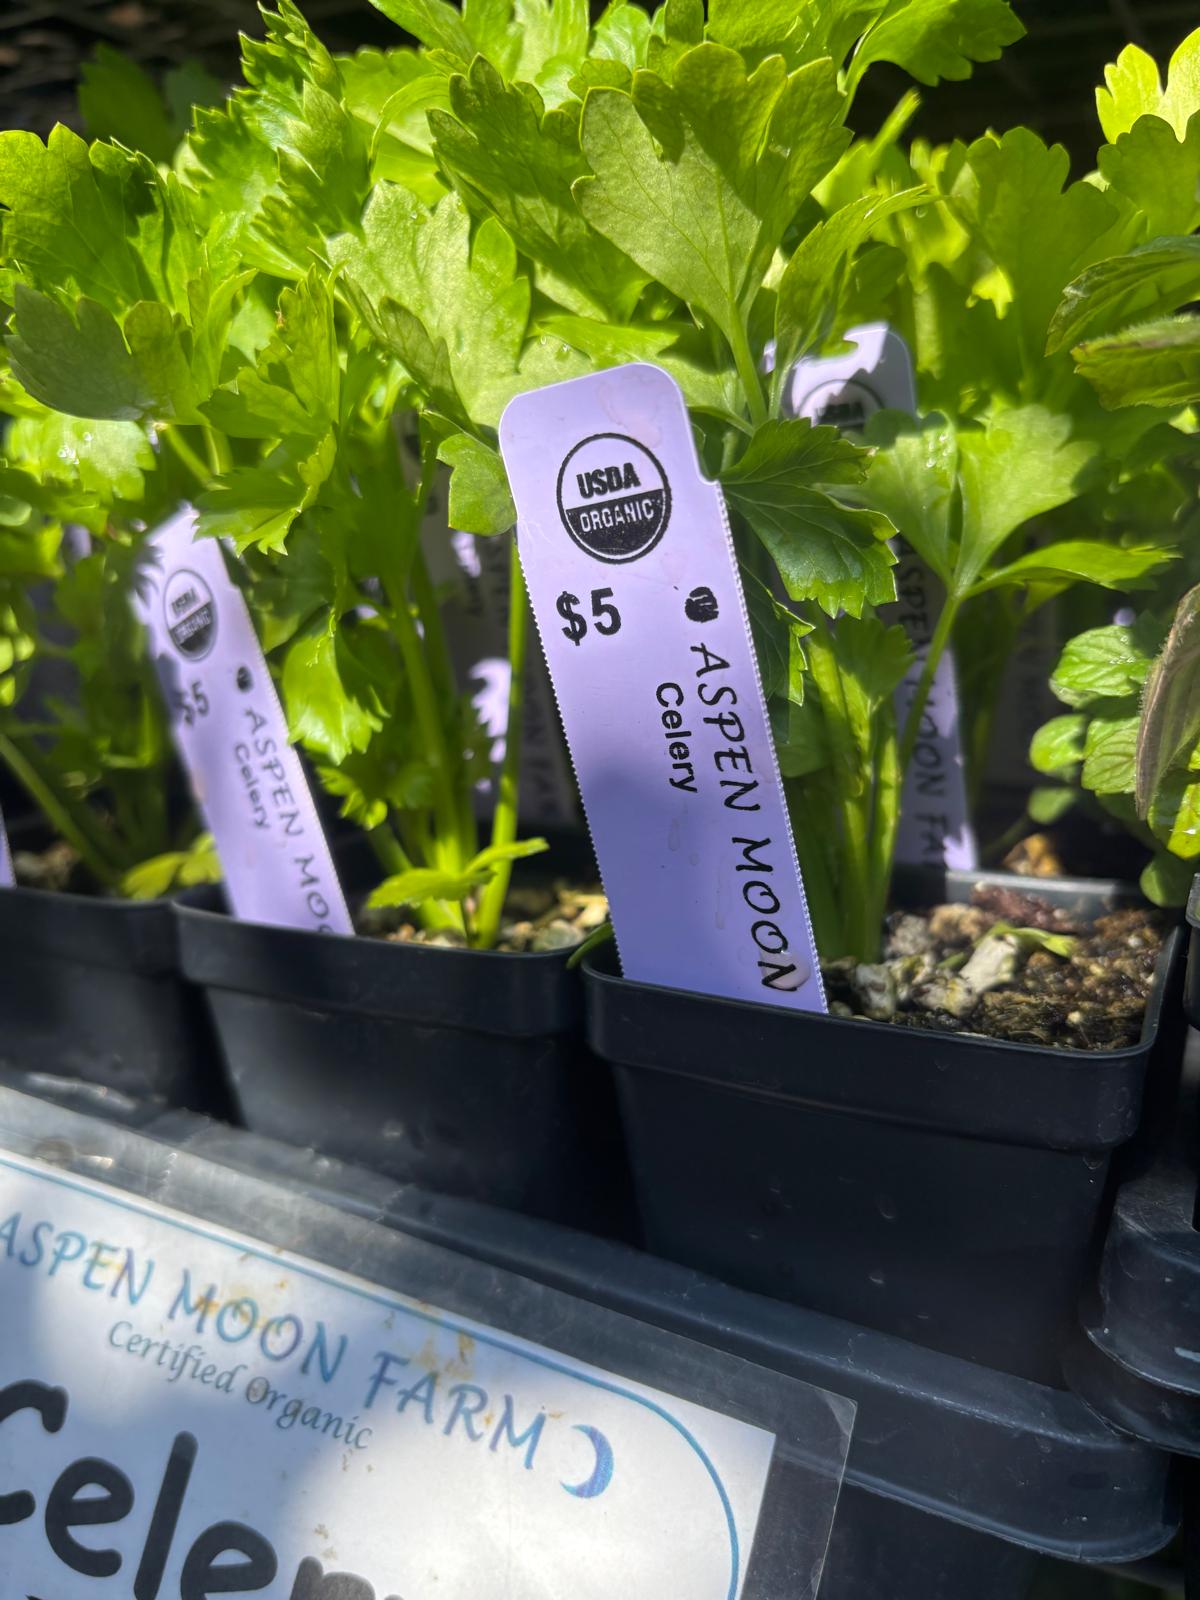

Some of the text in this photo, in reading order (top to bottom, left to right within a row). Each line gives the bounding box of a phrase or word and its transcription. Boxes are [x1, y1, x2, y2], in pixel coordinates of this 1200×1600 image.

[576, 462, 641, 498] USDA
[579, 498, 655, 533] ORGANIC
[556, 587, 622, 646] $5
[234, 742, 270, 830] Celery
[245, 706, 304, 838] ASPEN
[655, 682, 698, 793] Celery
[690, 641, 798, 992] ASPEN MOON
[0, 1211, 546, 1470] ASPEN MOON FARM
[108, 1320, 374, 1450] Certified Organic
